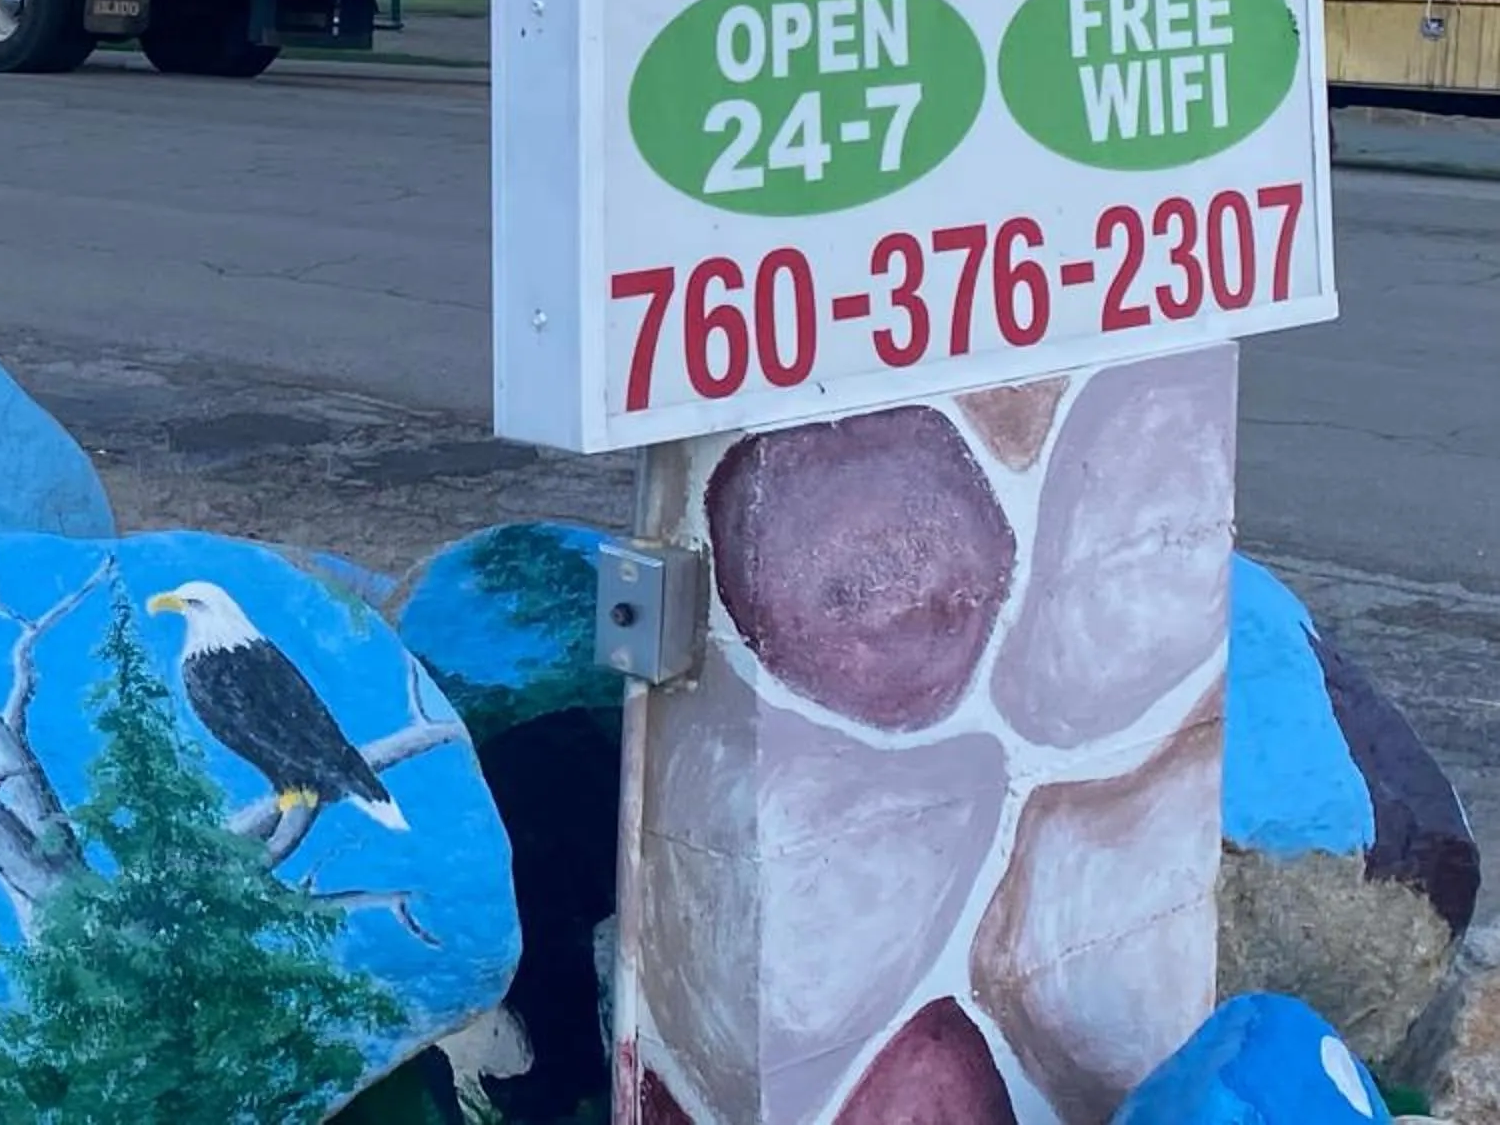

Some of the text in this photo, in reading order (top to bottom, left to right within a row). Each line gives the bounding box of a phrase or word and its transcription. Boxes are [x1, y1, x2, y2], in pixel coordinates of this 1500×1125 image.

[702, 83, 924, 194] 24-7
[1078, 53, 1228, 143] WIFI
[610, 182, 1304, 413] 760-376-2307
